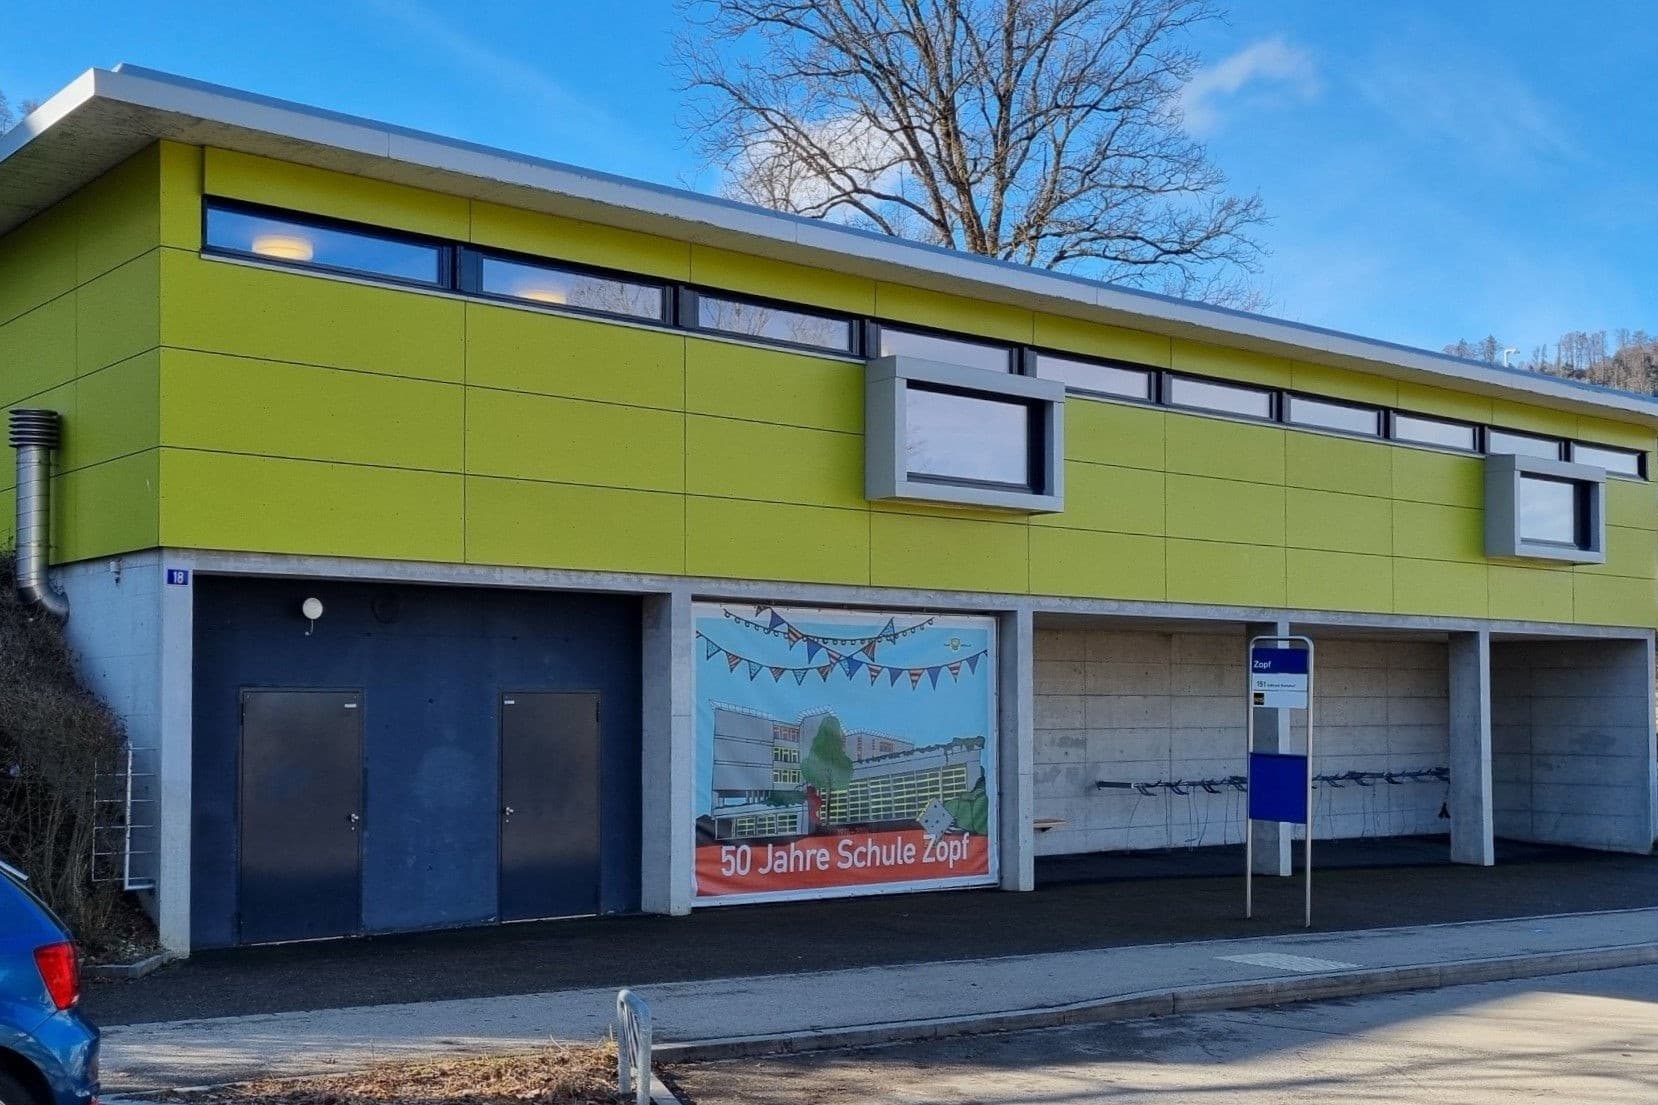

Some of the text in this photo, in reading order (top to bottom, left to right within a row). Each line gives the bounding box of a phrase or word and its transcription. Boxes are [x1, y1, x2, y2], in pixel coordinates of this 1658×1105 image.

[173, 571, 184, 584] 18
[1253, 660, 1272, 669] Zopf
[721, 833, 971, 876] 50 Jahre Schule Zopf
